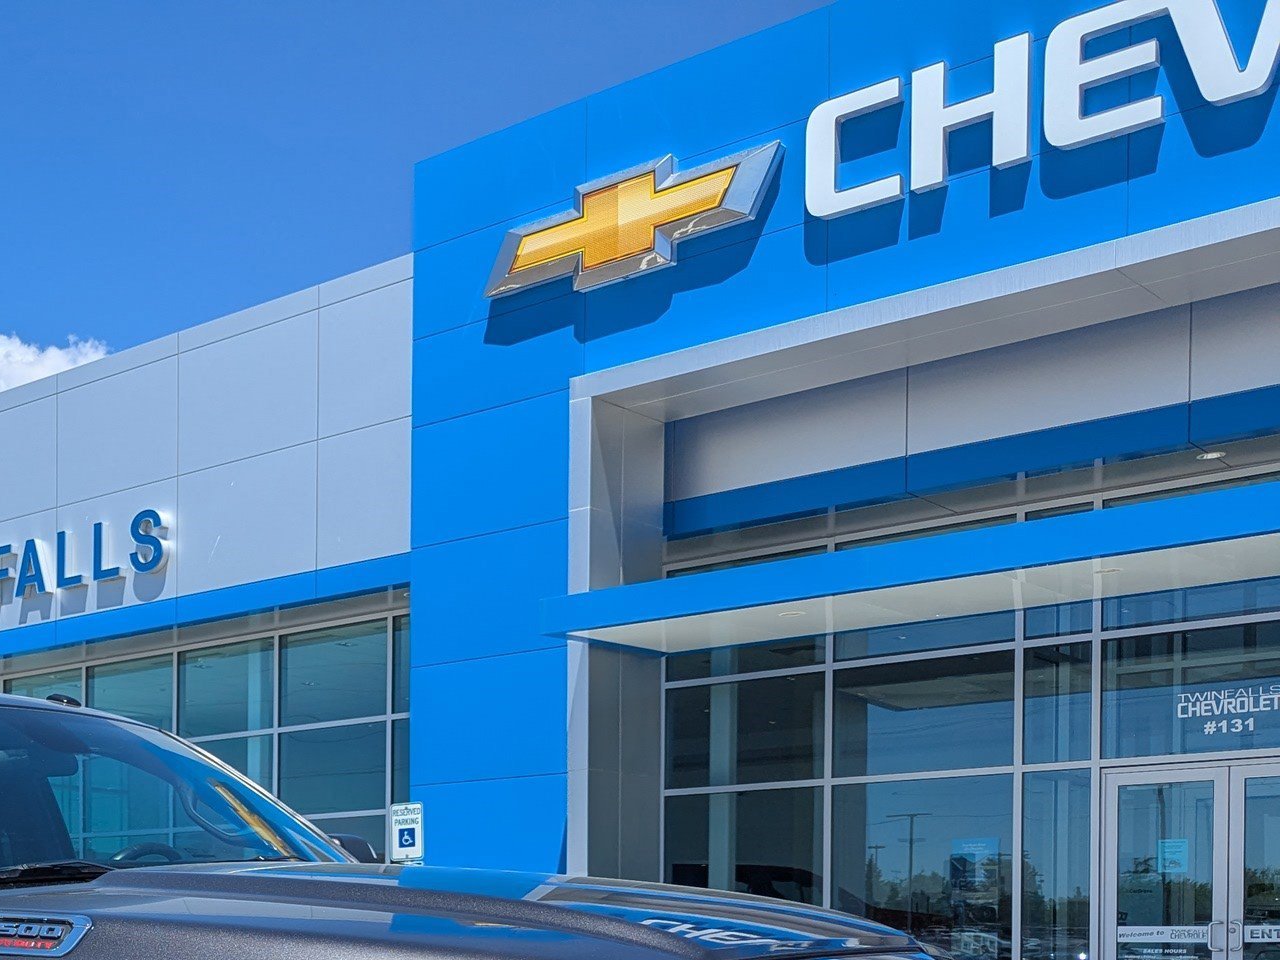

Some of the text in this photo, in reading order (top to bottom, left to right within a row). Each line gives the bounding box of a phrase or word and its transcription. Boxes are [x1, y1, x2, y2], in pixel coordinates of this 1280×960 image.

[805, 0, 1280, 220] CHEV
[1177, 694, 1280, 718] CHEVROLET
[1204, 718, 1254, 735] #131
[393, 807, 421, 817] RESERVED
[394, 817, 419, 826] PARKING
[1118, 931, 1154, 939] Welcome
[1169, 932, 1208, 940] CHEVROLE
